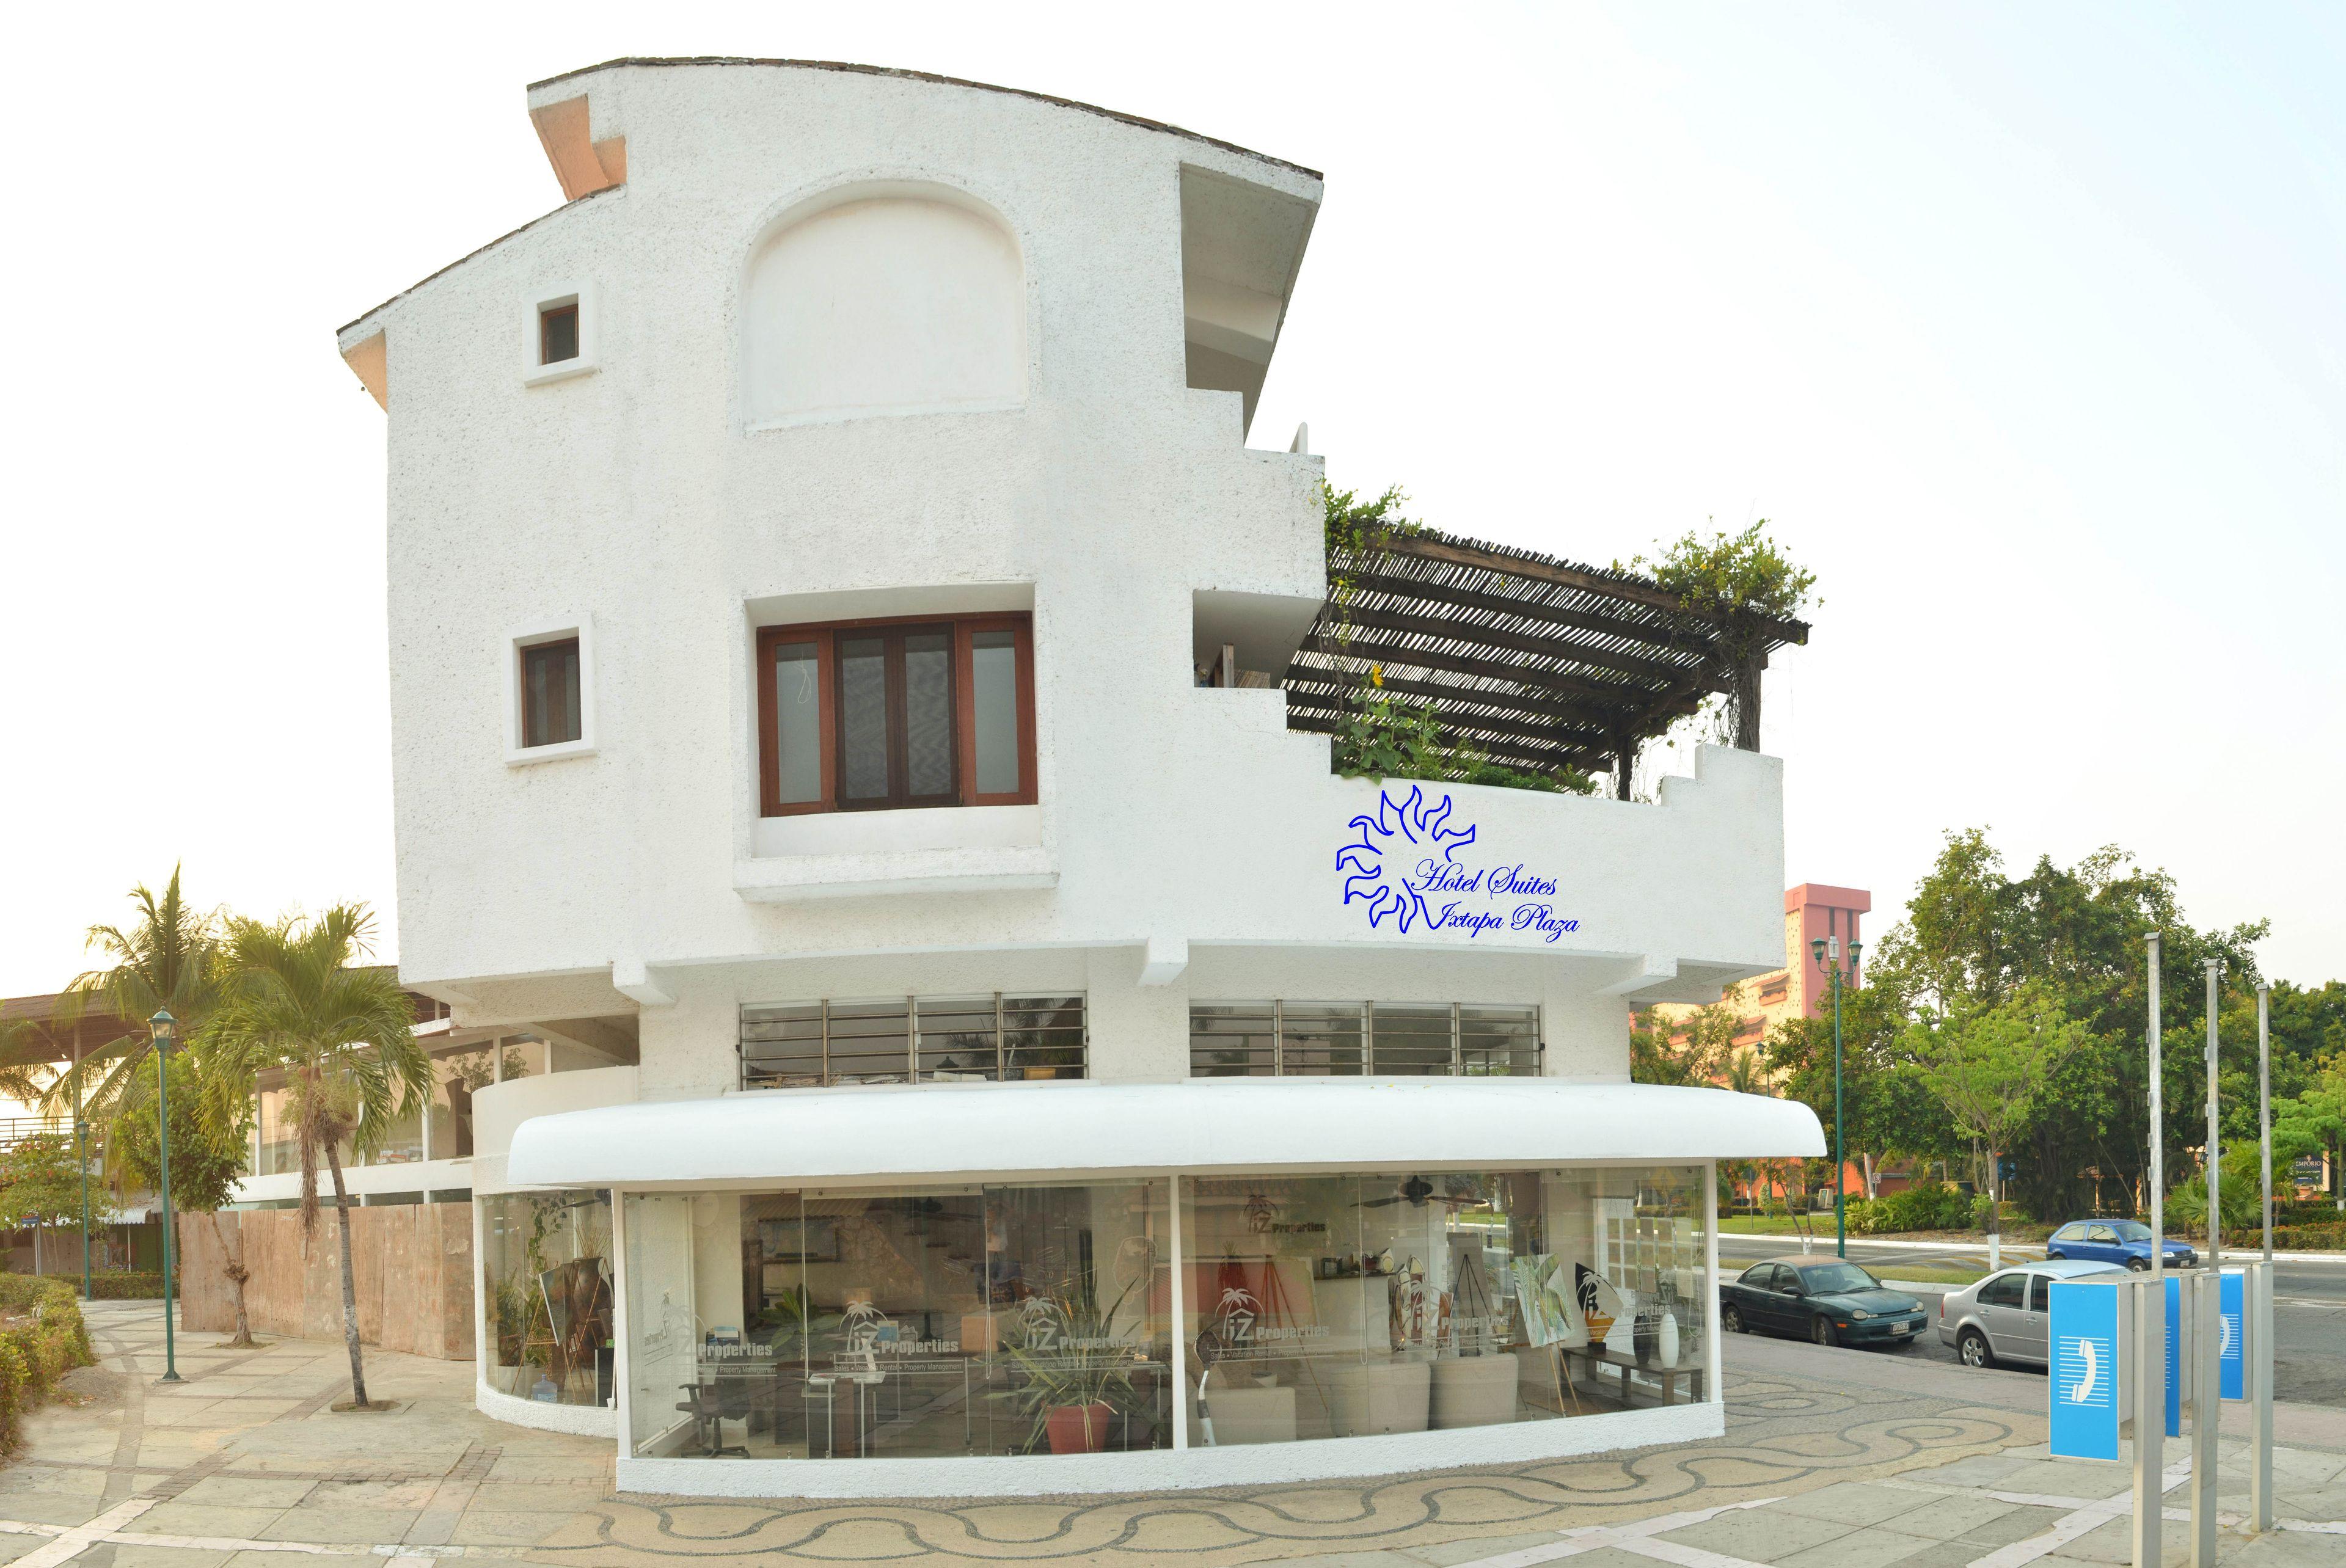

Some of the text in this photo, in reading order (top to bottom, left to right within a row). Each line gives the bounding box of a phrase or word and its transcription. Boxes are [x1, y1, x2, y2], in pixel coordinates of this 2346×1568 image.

[1411, 859, 1557, 900] Hotel Suites
[1441, 901, 1580, 943] Ixtapa Plaza
[1271, 1222, 1326, 1234] Properties
[1256, 1325, 1330, 1341] Properties
[698, 1343, 773, 1358] Properties
[881, 1339, 959, 1355] Properties
[1059, 1336, 1137, 1352] Properties
[1230, 1351, 1253, 1359] Vacation
[720, 1366, 741, 1374] Property
[742, 1365, 777, 1374] Management
[880, 1363, 897, 1372] Rental
[904, 1363, 926, 1372] Property
[927, 1362, 962, 1371] Management
